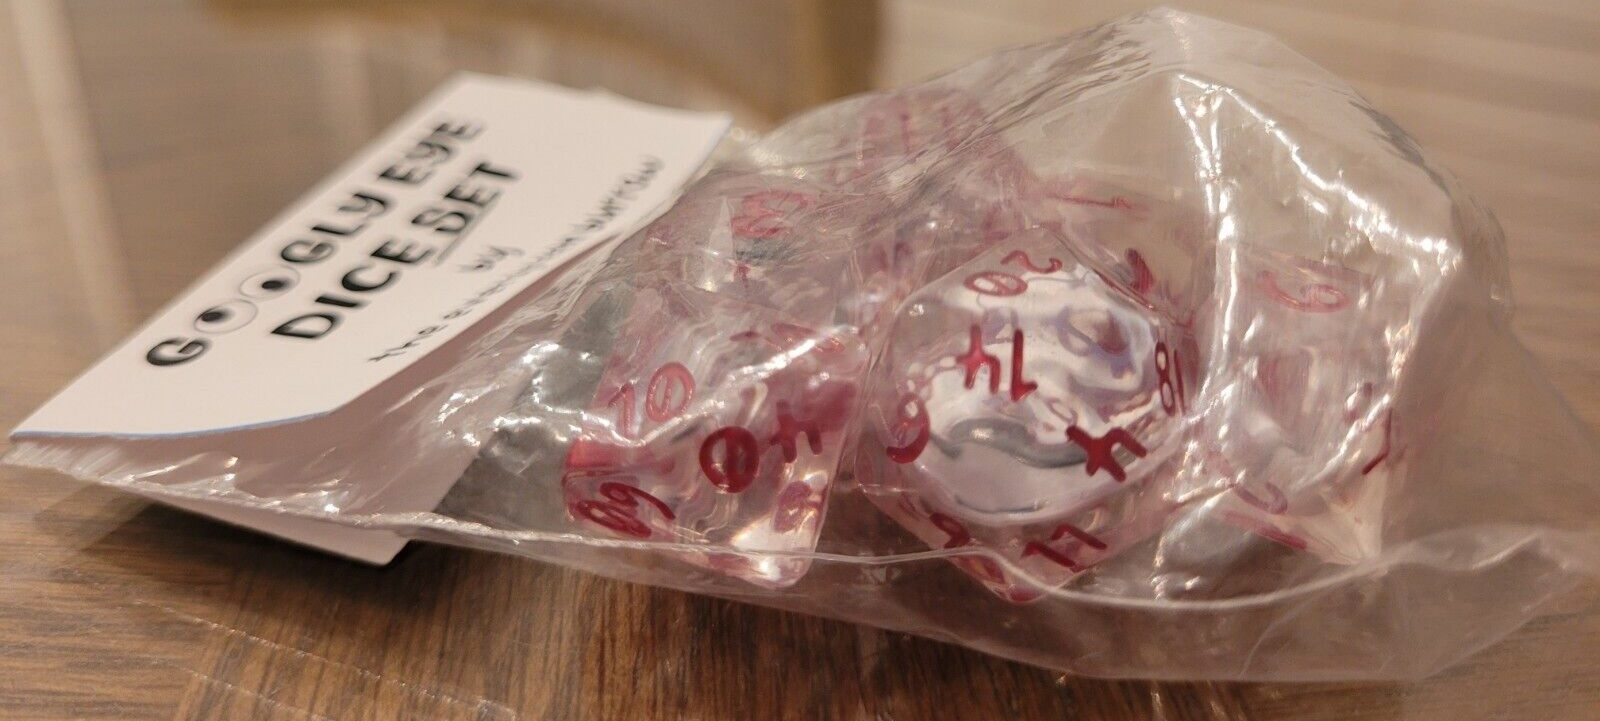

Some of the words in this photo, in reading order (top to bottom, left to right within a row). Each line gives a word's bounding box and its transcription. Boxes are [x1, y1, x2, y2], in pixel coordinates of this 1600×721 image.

[381, 118, 484, 186] EYE
[271, 238, 435, 342] DICE
[411, 160, 520, 233] SET
[460, 245, 524, 273] by
[368, 320, 449, 362] the
[608, 361, 696, 437] 10
